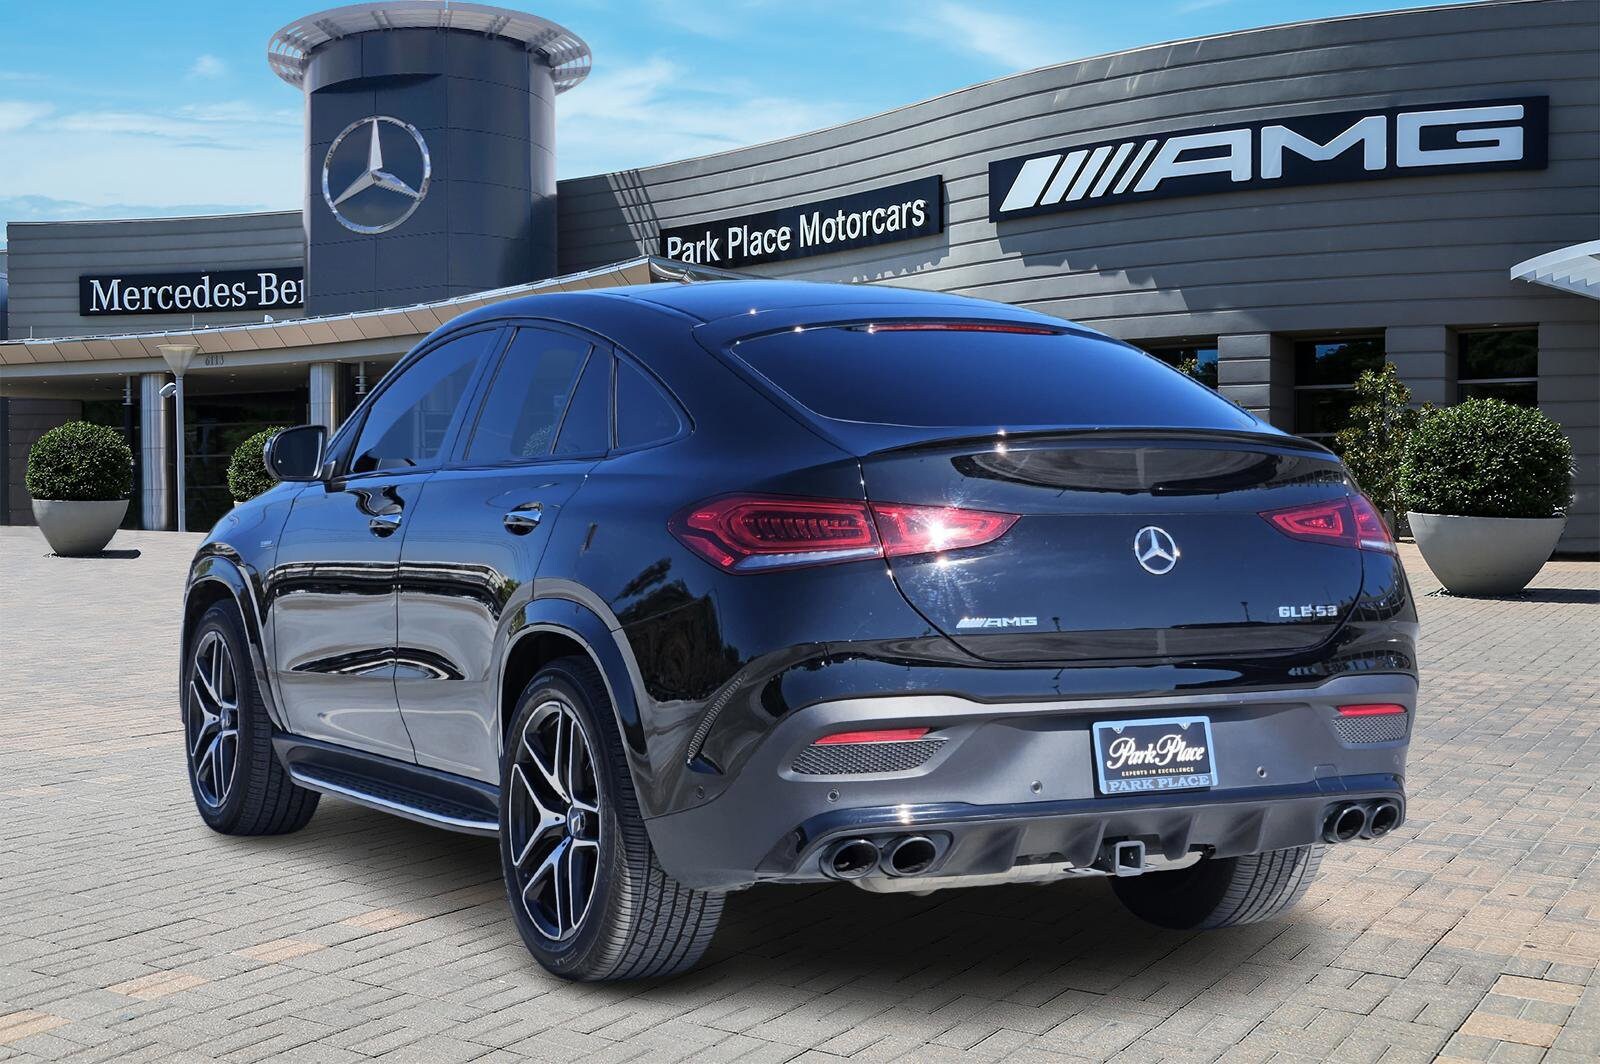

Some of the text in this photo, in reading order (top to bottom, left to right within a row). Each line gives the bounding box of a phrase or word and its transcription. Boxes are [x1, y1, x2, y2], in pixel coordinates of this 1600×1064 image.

[667, 199, 926, 264] Park Place Motorcars
[1278, 605, 1338, 618] GLE 53
[1106, 734, 1205, 769] Park Place
[1108, 775, 1210, 792] PARK PLACE
